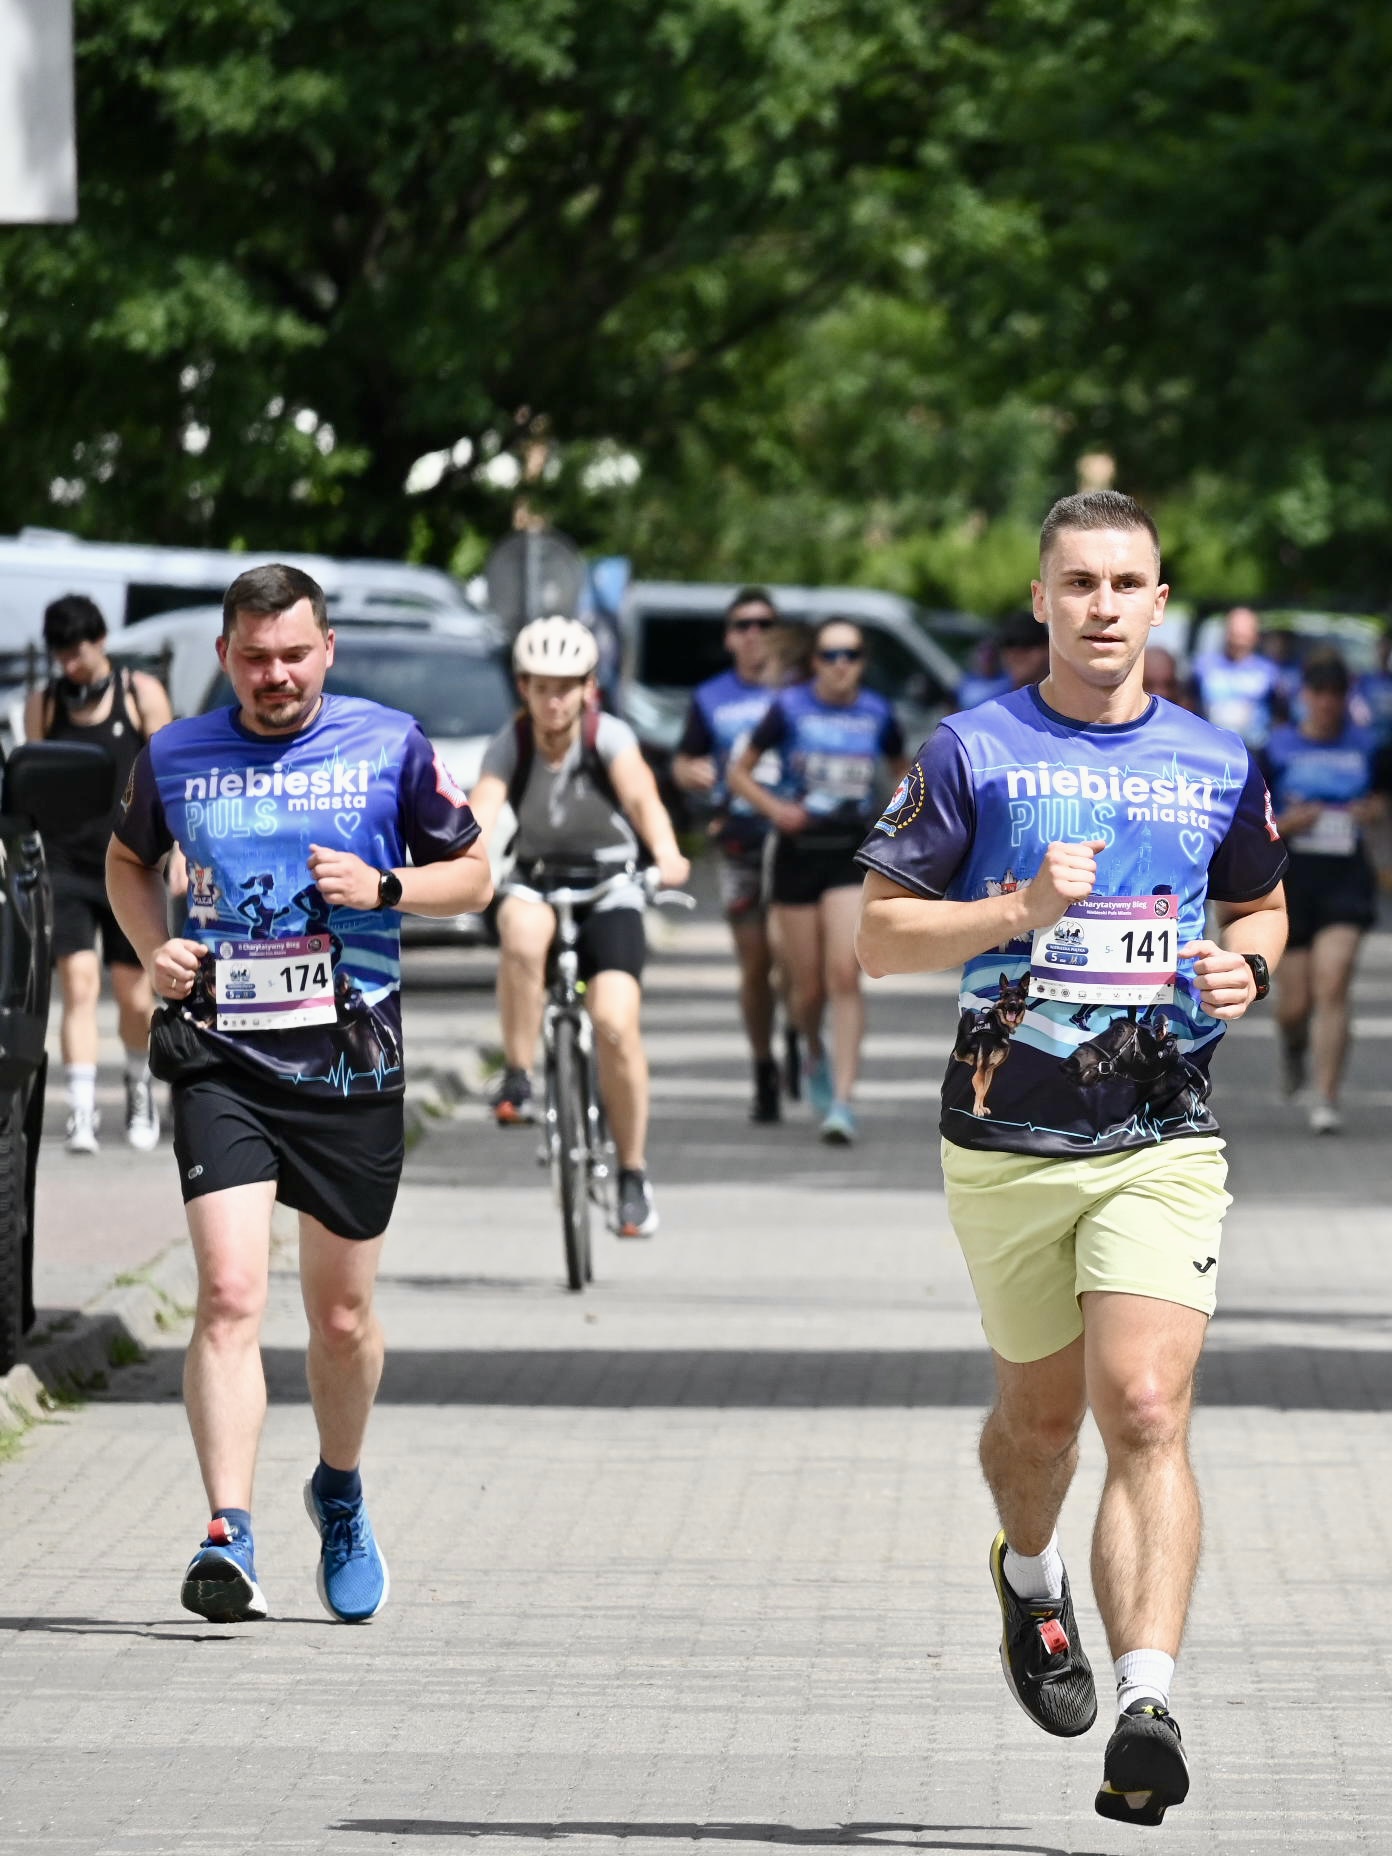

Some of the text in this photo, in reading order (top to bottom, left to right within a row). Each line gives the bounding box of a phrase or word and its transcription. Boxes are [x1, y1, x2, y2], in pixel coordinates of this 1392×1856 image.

[184, 760, 369, 800] niebieski
[1006, 761, 1213, 811] niebieski
[287, 793, 367, 812] miasta
[1127, 803, 1209, 830] miasta
[185, 798, 278, 841] PULS
[1008, 798, 1116, 848] PULS
[1078, 900, 1131, 910] Charytatywny
[1132, 901, 1147, 909] Bieg
[1051, 952, 1058, 962] 5
[1120, 930, 1169, 964] 141
[280, 962, 329, 993] 174
